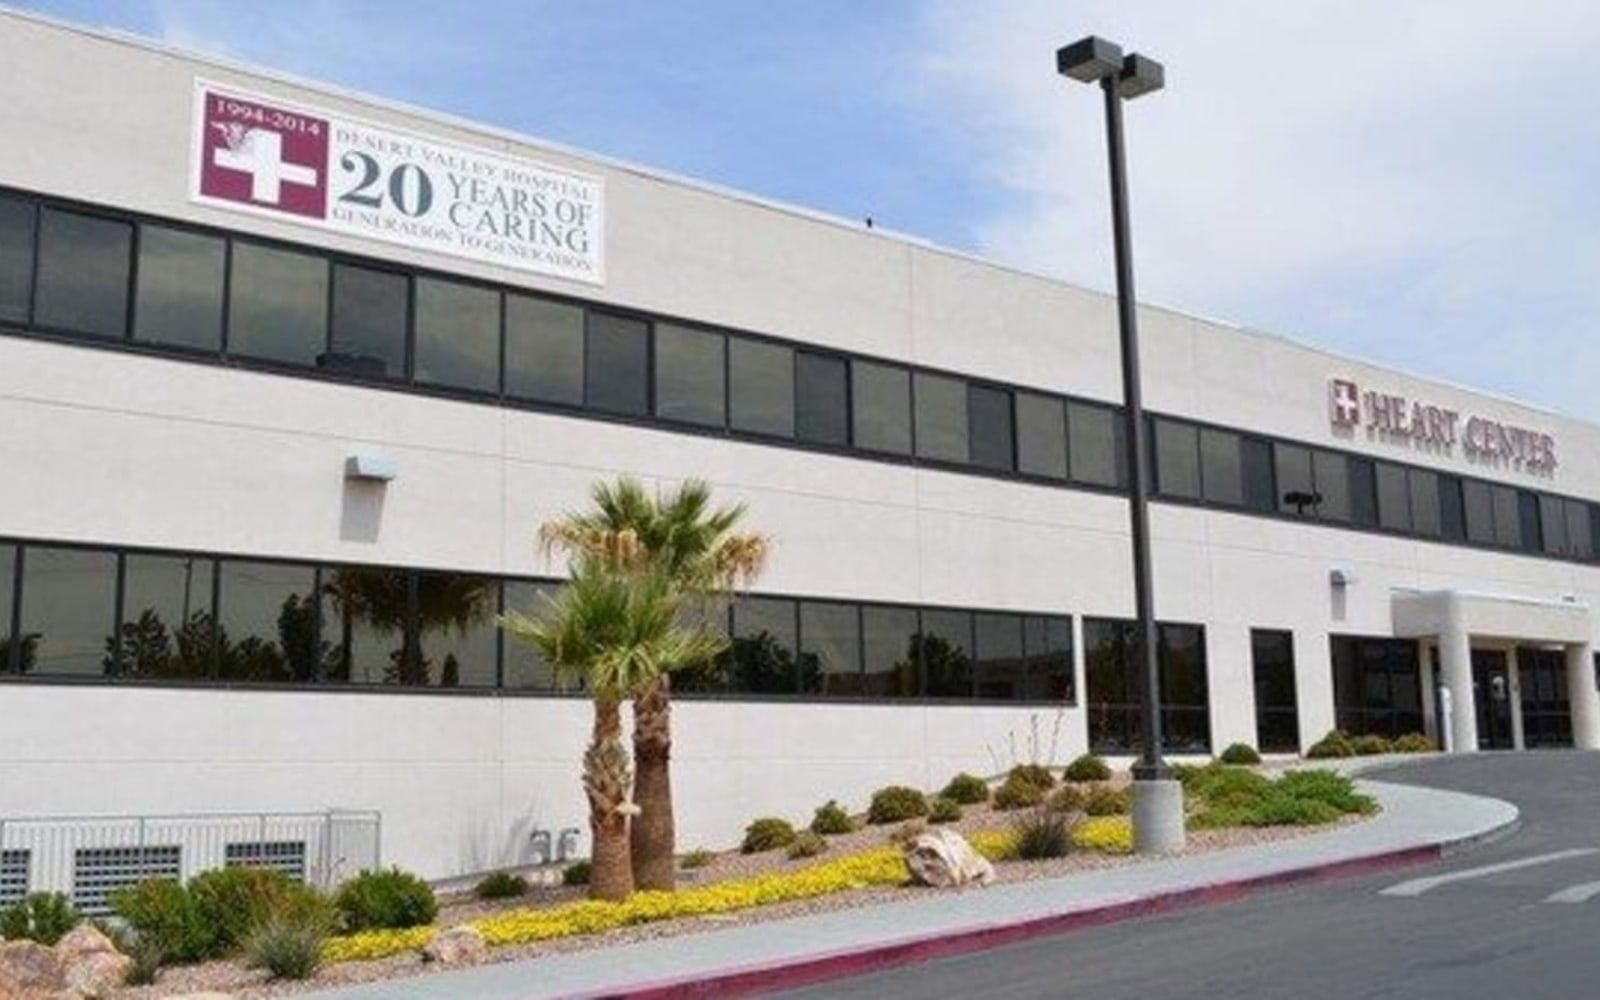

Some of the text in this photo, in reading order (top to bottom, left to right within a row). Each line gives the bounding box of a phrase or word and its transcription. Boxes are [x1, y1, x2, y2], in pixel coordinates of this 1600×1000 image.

[217, 99, 321, 136] 1994-2014
[338, 149, 593, 227] 20 YEARS OF
[422, 147, 497, 177] VALLEY
[448, 200, 589, 253] CARING
[1363, 390, 1559, 470] HEART CENTER
